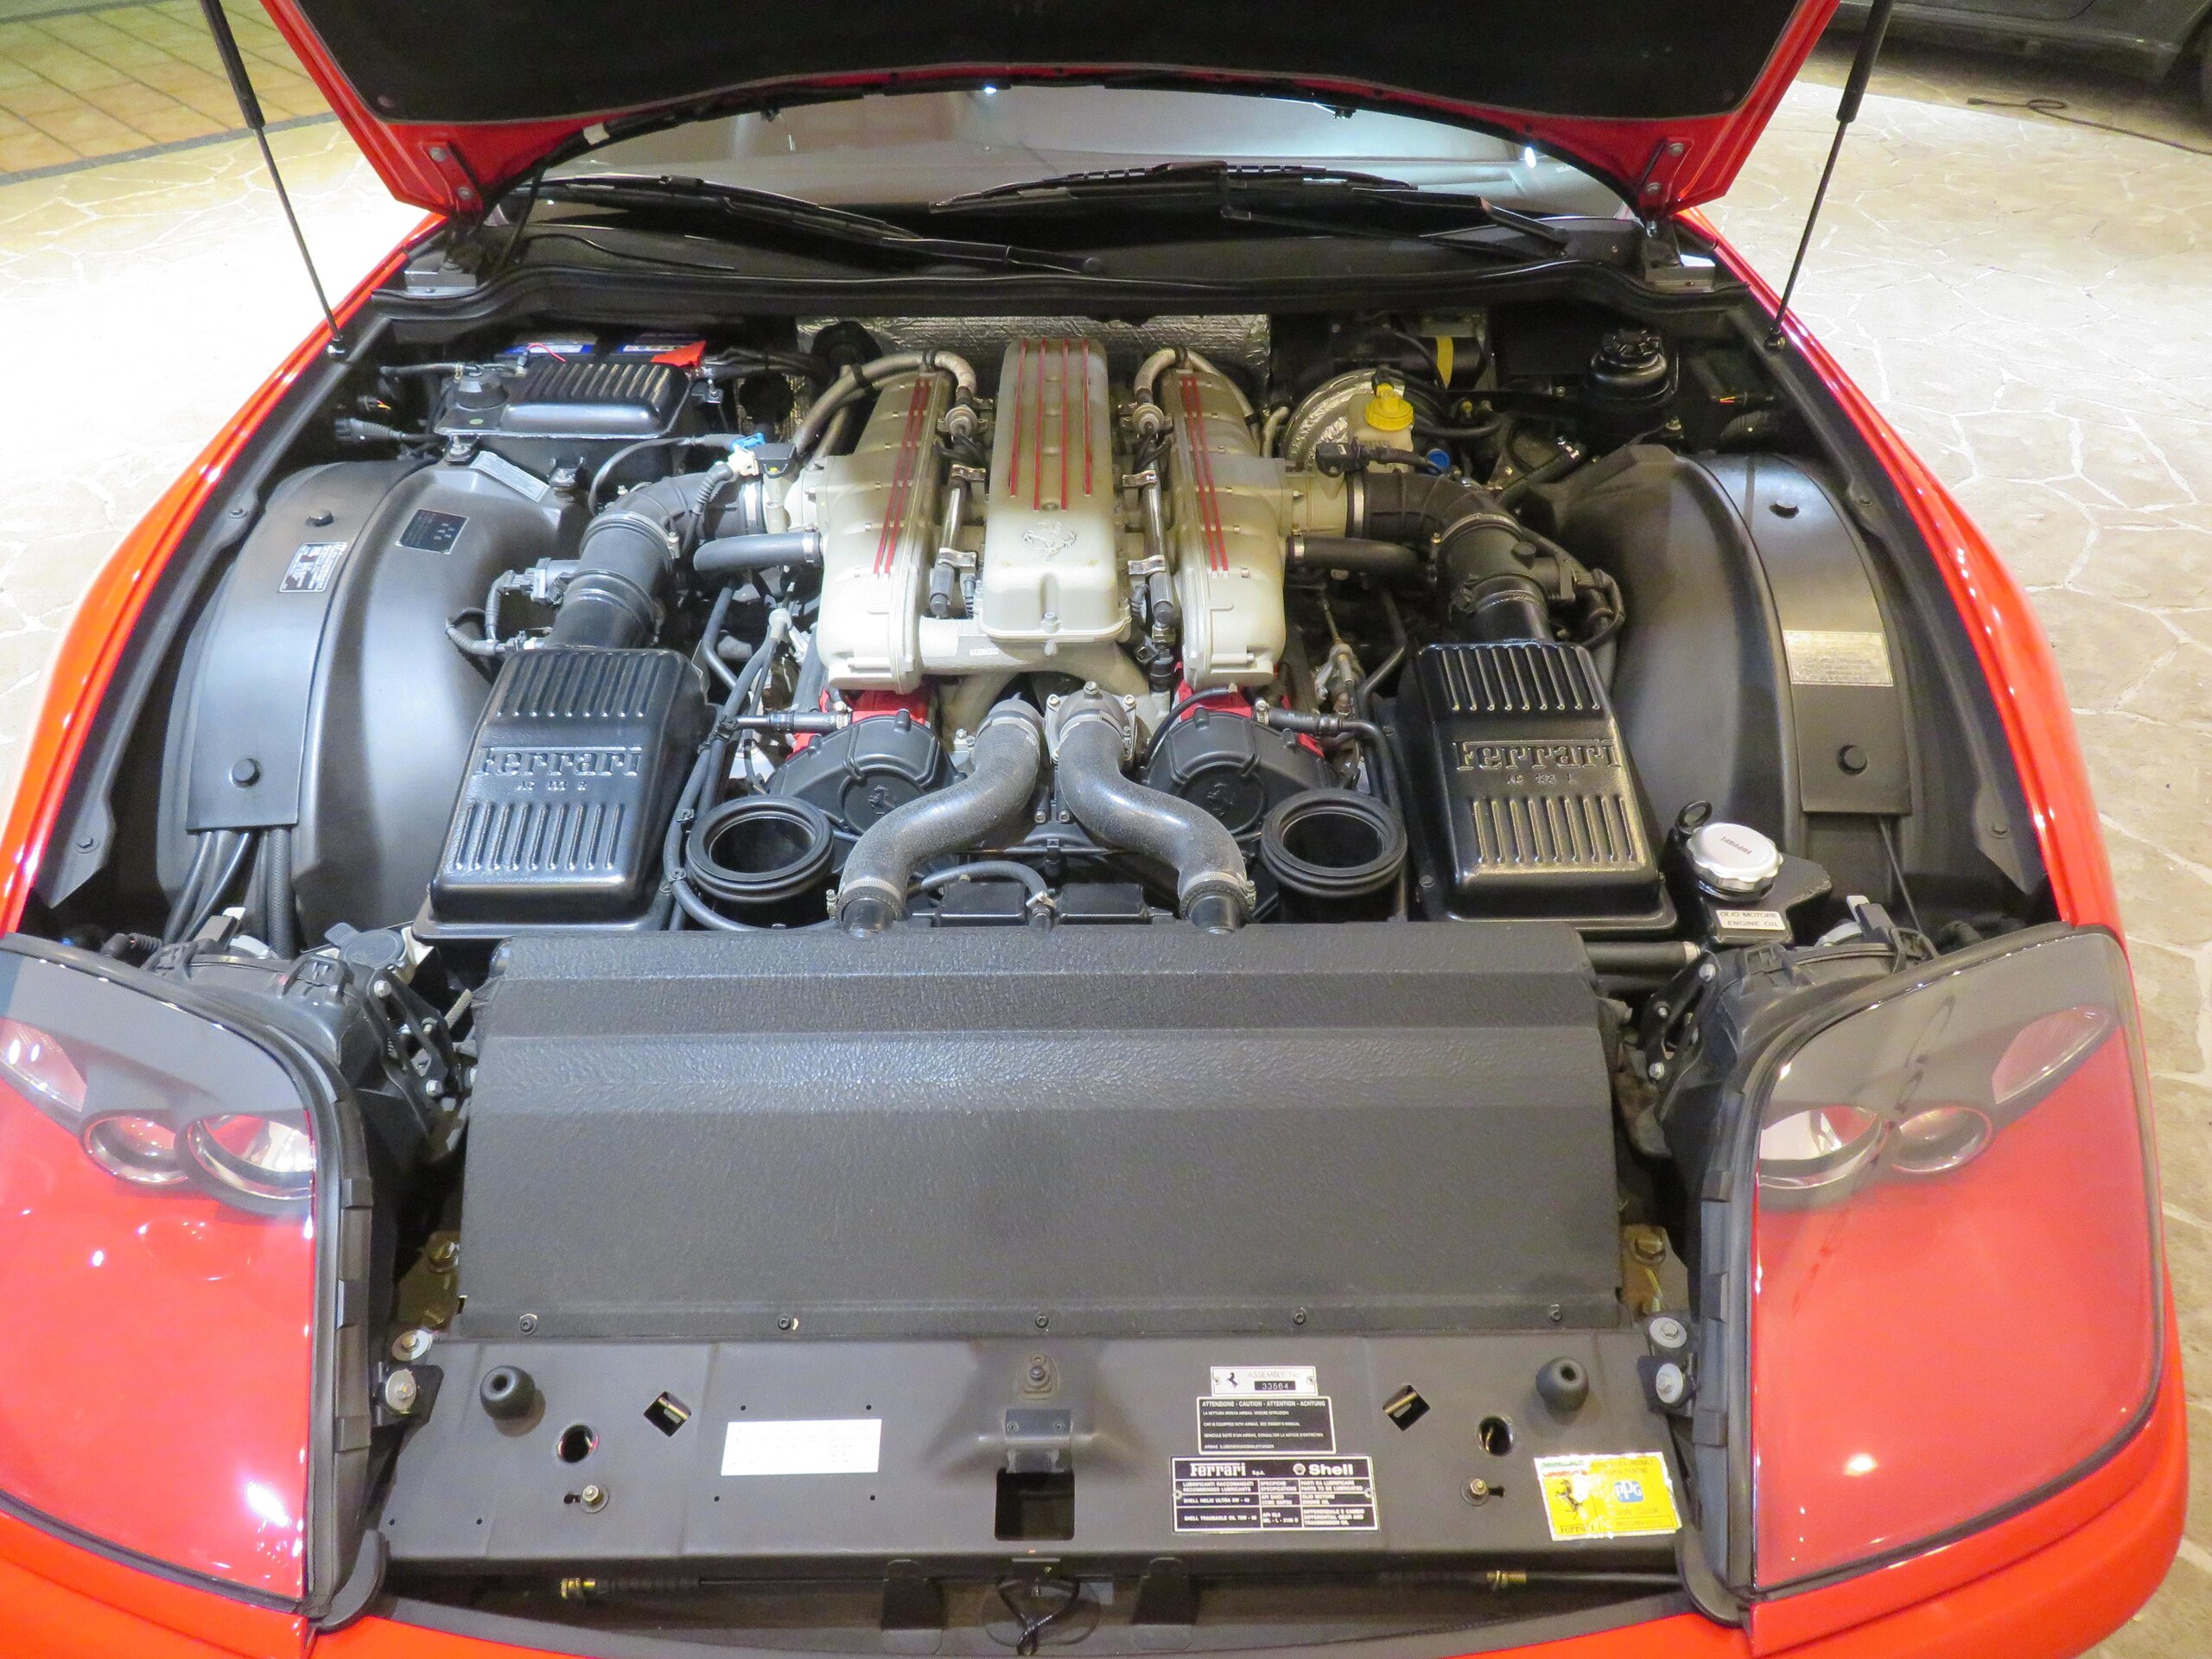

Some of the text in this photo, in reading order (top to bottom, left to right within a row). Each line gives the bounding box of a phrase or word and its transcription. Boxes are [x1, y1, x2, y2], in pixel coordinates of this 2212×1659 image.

[474, 746, 642, 777] Ferrari
[1452, 739, 1622, 771] Ferrari
[1190, 1462, 1246, 1477] Ferrari
[1308, 1464, 1354, 1476] Shell
[1615, 1480, 1643, 1499] PPG
